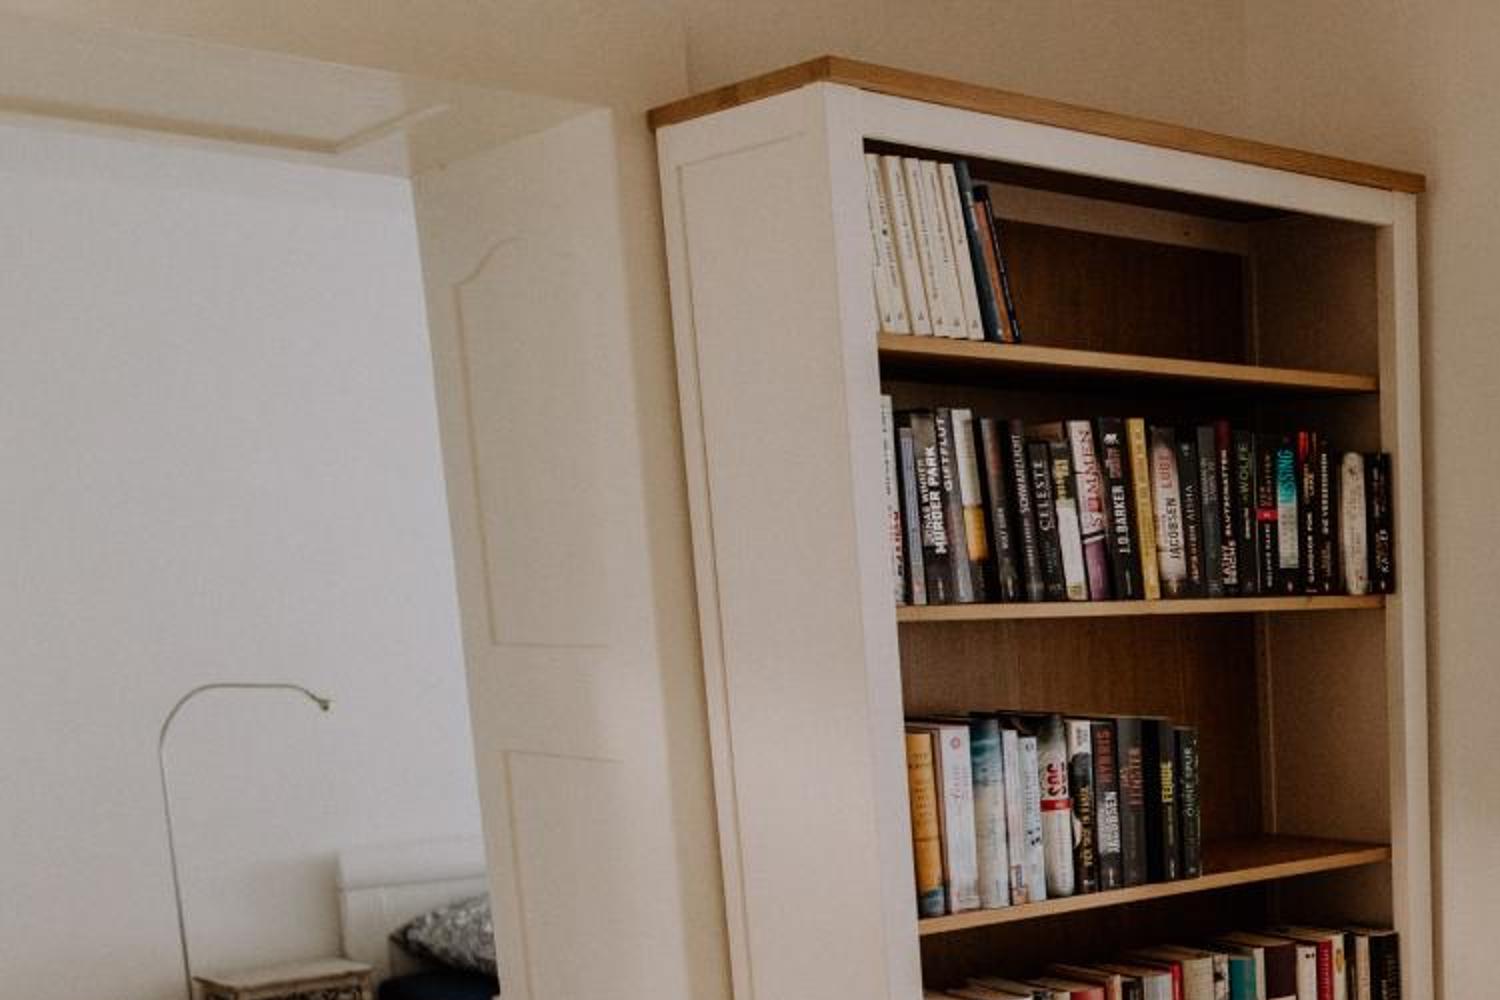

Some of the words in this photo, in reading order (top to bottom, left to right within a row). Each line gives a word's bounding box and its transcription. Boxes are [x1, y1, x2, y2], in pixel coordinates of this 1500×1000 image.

[924, 445, 942, 487] PARK
[935, 415, 954, 492] GIFTFLUT
[929, 491, 948, 555] MURDER
[1033, 459, 1050, 532] CELESTE
[1165, 497, 1183, 561] JACOBSEN
[1184, 746, 1194, 779] SPUR
